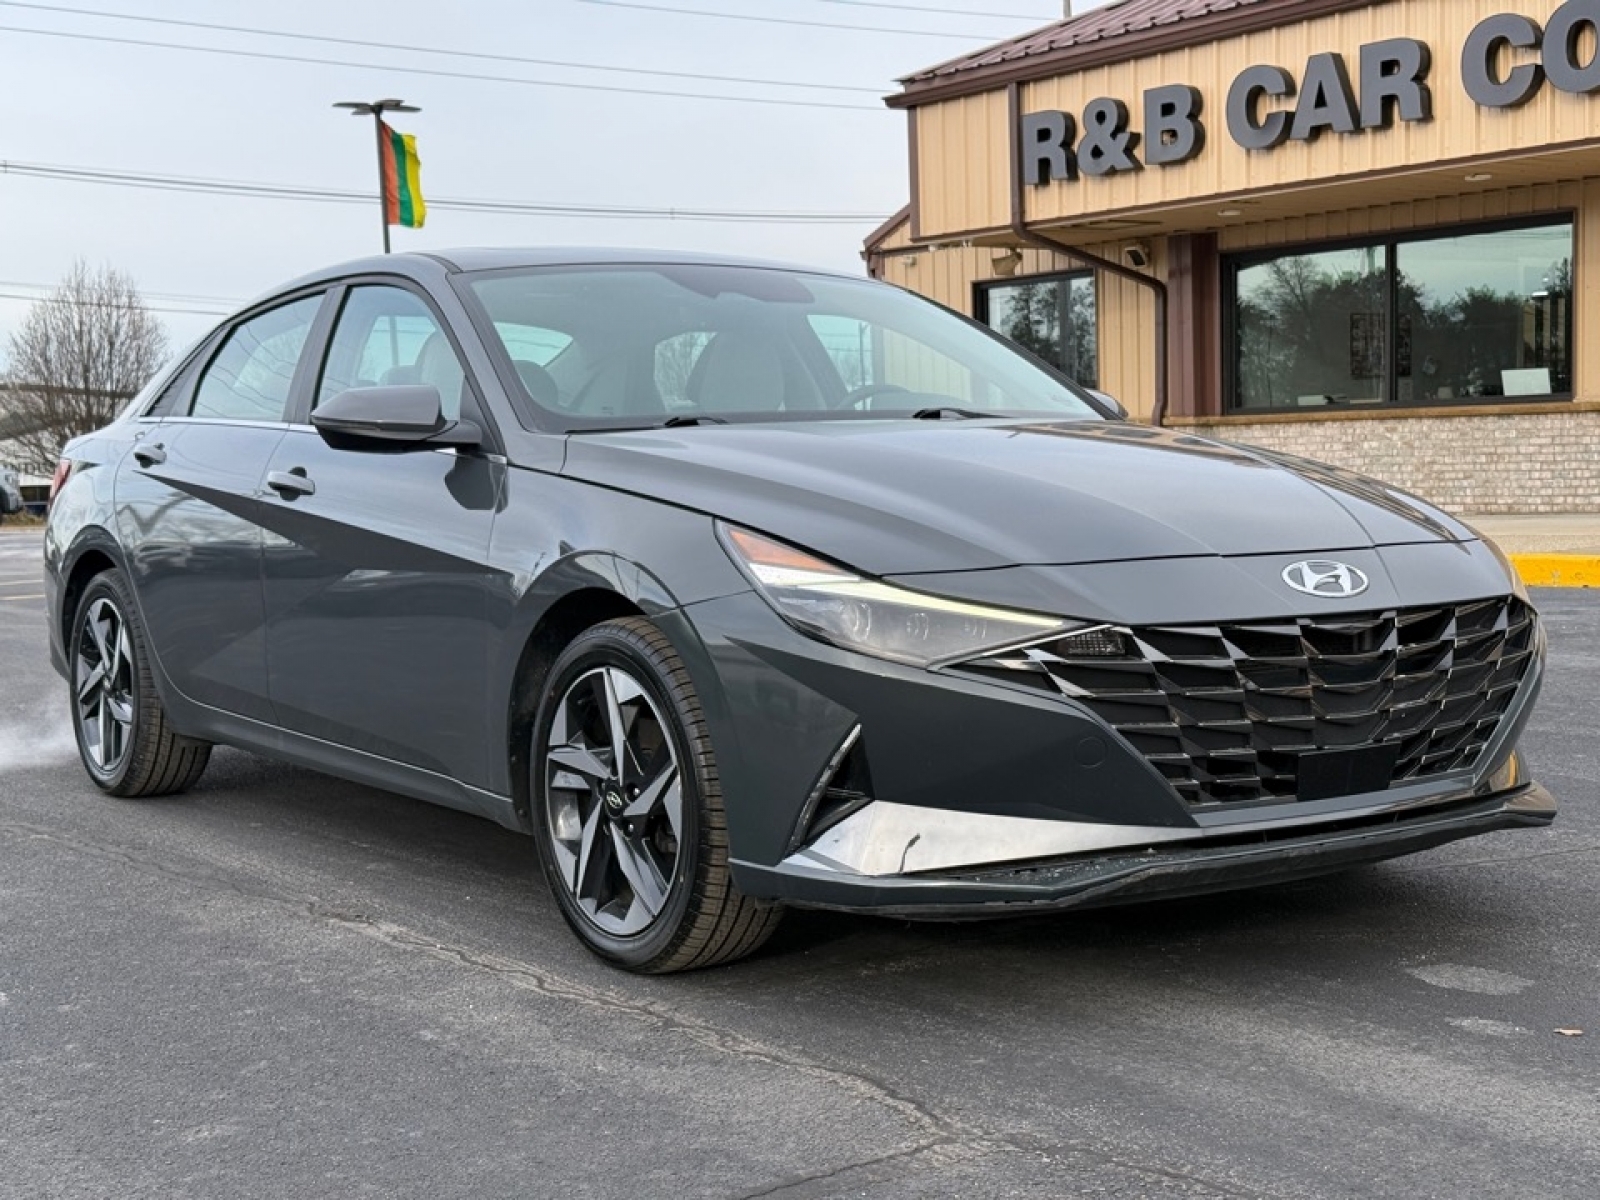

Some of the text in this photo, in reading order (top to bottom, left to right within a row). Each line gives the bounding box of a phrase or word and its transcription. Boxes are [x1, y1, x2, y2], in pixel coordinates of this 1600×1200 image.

[1022, 0, 1600, 186] R&B CAR CO
